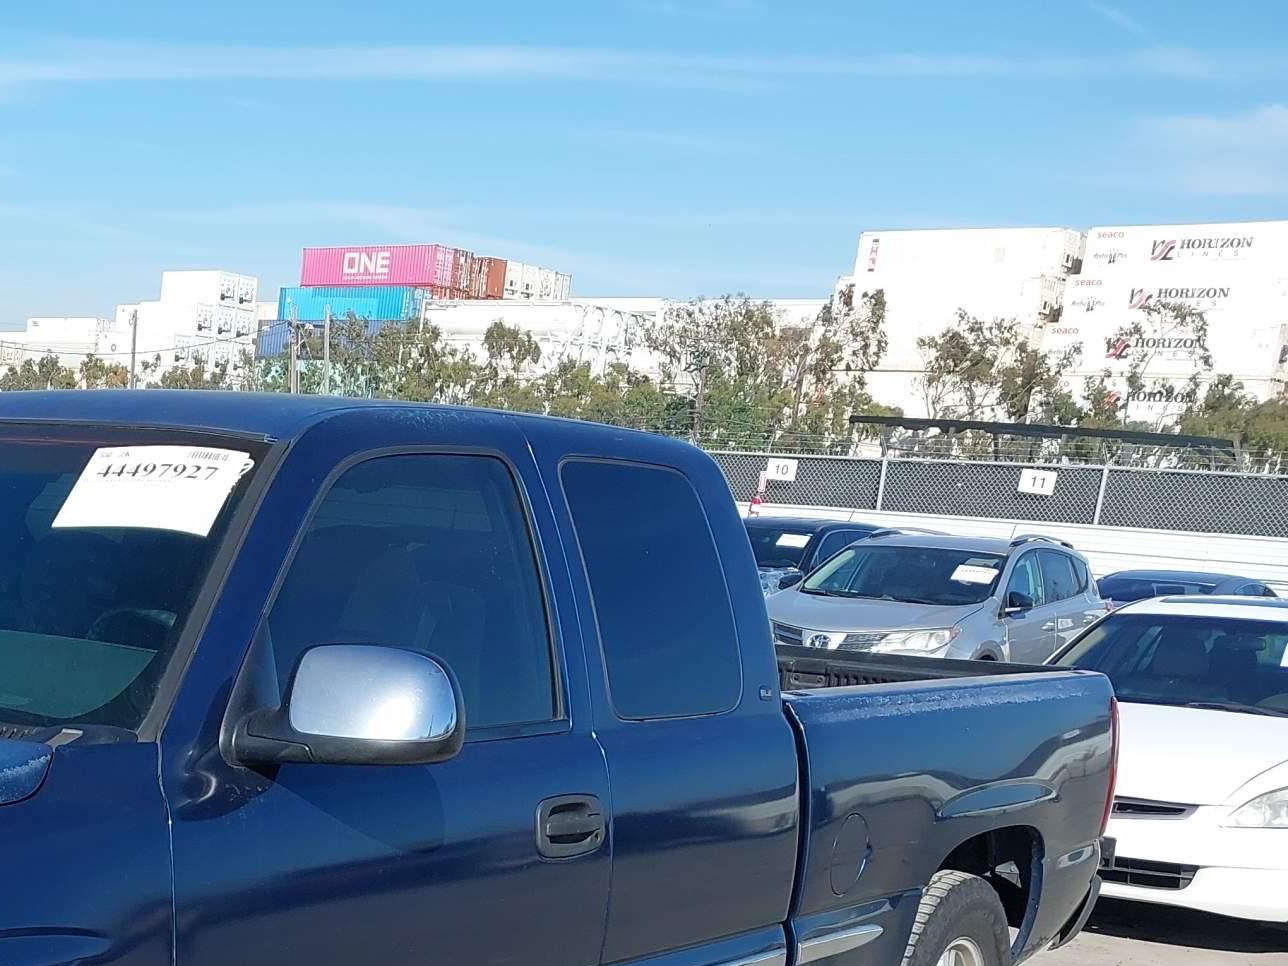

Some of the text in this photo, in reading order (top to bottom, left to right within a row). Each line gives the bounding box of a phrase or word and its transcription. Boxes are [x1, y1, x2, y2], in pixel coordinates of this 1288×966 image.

[1096, 231, 1125, 239] seaco
[1179, 237, 1254, 250] HORIZON
[1176, 249, 1240, 258] LINES
[343, 251, 391, 274] ONE
[1075, 279, 1103, 287] seaco
[1156, 287, 1231, 299] HORIZON
[1051, 327, 1079, 335] seaco
[1133, 337, 1207, 349] HORIZON
[96, 462, 220, 481] 44497927
[775, 463, 789, 476] 10
[1031, 476, 1046, 489] 11
